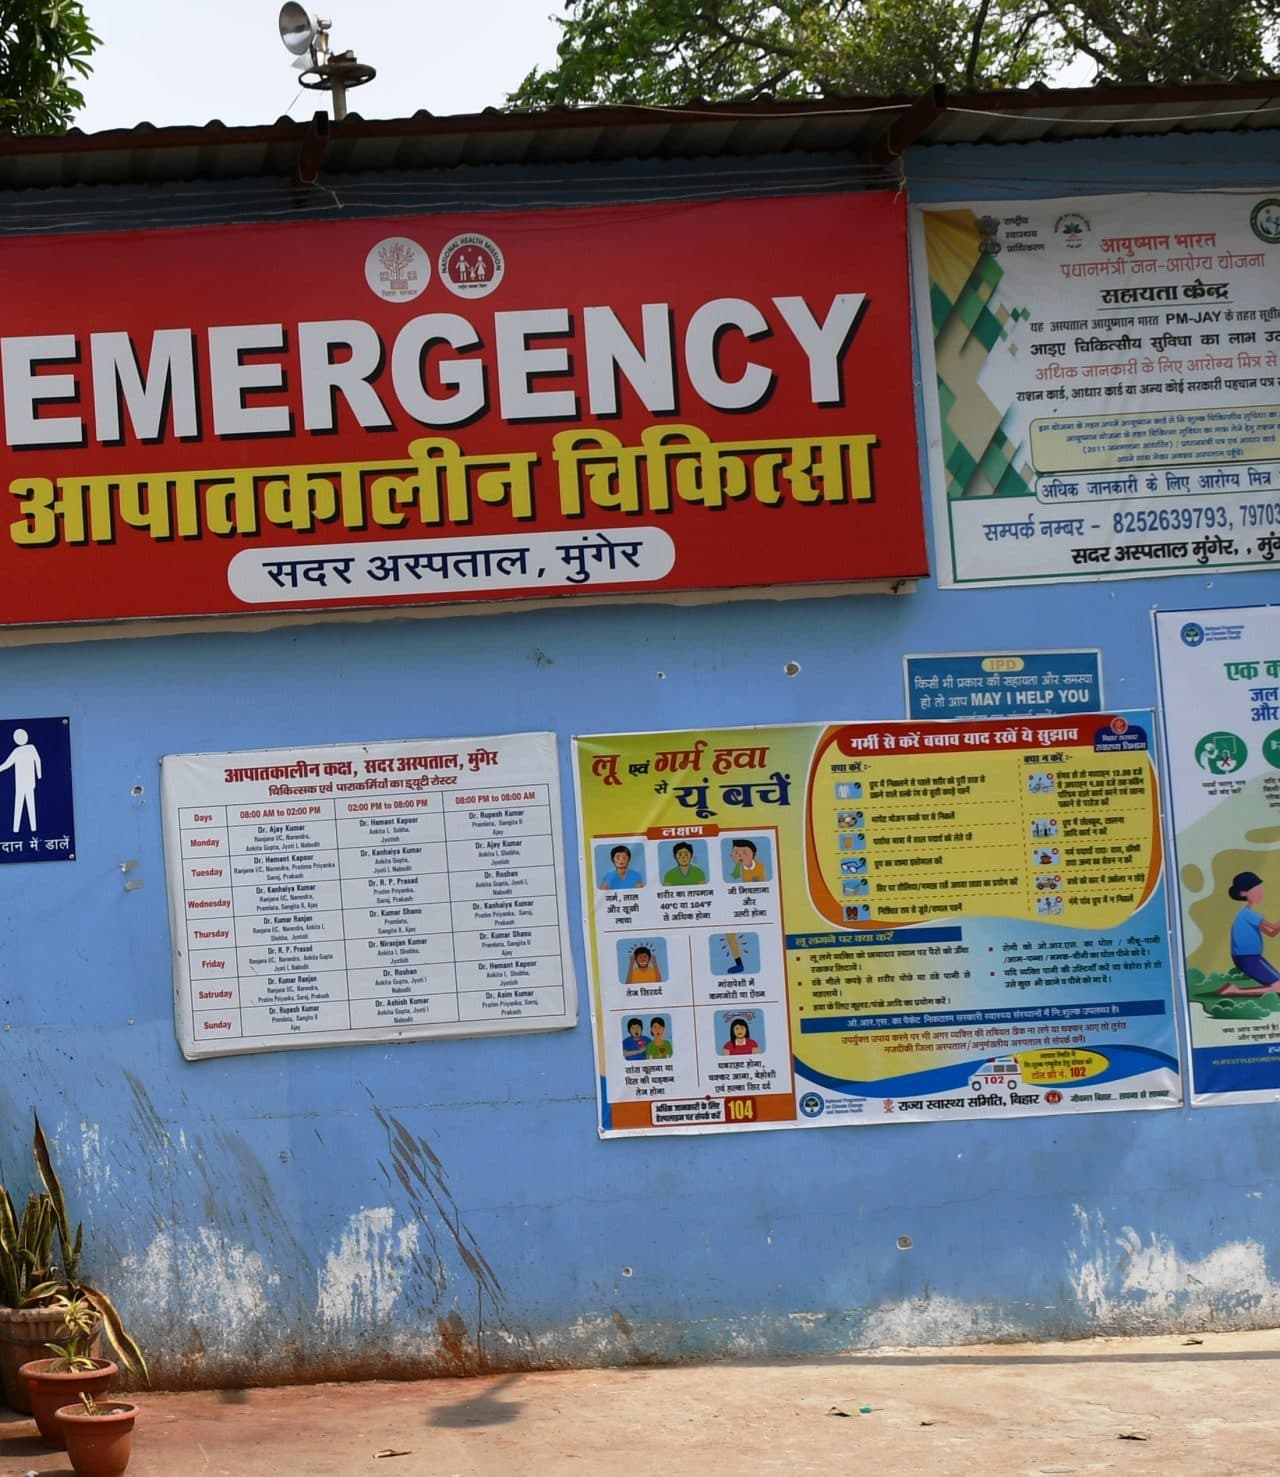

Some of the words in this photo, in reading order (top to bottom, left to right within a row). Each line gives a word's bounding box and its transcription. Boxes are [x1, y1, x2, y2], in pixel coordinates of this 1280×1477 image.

[1099, 234, 1170, 257] आयुष्मान
[1173, 232, 1216, 250] भारत
[442, 242, 460, 274] NATIONAL
[460, 237, 483, 245] HEALTH
[484, 242, 502, 271] MISSION
[1059, 258, 1129, 278] प्रधानमंत्री
[1127, 254, 1213, 274] जन-आरोग्य
[1216, 252, 1265, 269] योजना
[1099, 285, 1178, 304] सहायता
[1181, 279, 1229, 299] केन्द्र
[1165, 310, 1222, 325] PM-JAY
[1030, 342, 1066, 358] आइए
[1073, 333, 1142, 353] चिकित्सीय
[1149, 331, 1192, 352] सुविधा
[1199, 333, 1220, 345] का
[1227, 331, 1256, 344] लाभ
[0, 292, 868, 449] EMERGENCY
[1034, 363, 1079, 381] अधिक
[1080, 359, 1138, 377] जानकारी
[1140, 358, 1155, 373] के
[1157, 357, 1183, 375] लिए
[1186, 354, 1234, 371] आरोग्य
[1236, 352, 1262, 369] मित्र
[1263, 351, 1278, 367] से
[7, 437, 539, 546] आपातकालीन
[552, 424, 878, 517] चिकित्सा
[1040, 478, 1079, 498] अधिक
[1086, 474, 1138, 495] जानकारी
[1144, 473, 1158, 492] के
[1164, 472, 1190, 492] लिए
[1198, 469, 1240, 488] आरोग्य
[1247, 467, 1271, 486] मित्र
[981, 513, 1035, 541] सम्पर्क
[1038, 518, 1084, 538] नम्बर
[1112, 506, 1233, 534] 8252639793,
[1070, 546, 1111, 564] सदर
[1113, 541, 1189, 562] अस्पताल
[1191, 534, 1239, 564] मुंगेर,
[261, 557, 355, 588] सदर
[554, 533, 643, 584] मुंगेर
[989, 660, 1017, 670] IPD
[1224, 660, 1260, 681] एक
[913, 674, 939, 689] किसी
[941, 674, 954, 688] भी
[955, 676, 984, 688] प्रकार
[985, 672, 1000, 686] की
[1002, 674, 1038, 688] सहायता
[1041, 671, 1060, 685] और
[1061, 673, 1093, 684] समस्या
[919, 694, 931, 710] हो
[933, 693, 945, 707] तो
[948, 696, 968, 707] आप
[970, 691, 1002, 706] MAY
[1006, 691, 1011, 705] I
[1015, 689, 1054, 704] HELP
[1057, 688, 1089, 703] YOU
[1248, 687, 1278, 702] जल
[1251, 702, 1279, 722] और
[850, 733, 879, 750] गर्मी
[882, 732, 896, 749] से
[897, 731, 920, 748] करें
[922, 733, 960, 747] बचाव
[962, 731, 990, 745] याद
[992, 726, 1018, 744] रखें
[1020, 726, 1033, 742] ये
[1036, 727, 1078, 746] सुझाव
[223, 759, 321, 783] आपातकालीन
[322, 760, 358, 778] कक्ष,
[363, 758, 395, 774] सदर
[396, 753, 464, 772] अस्पताल,
[466, 747, 498, 772] मुंगेर
[592, 754, 622, 785] लू
[628, 760, 650, 777] एवं
[654, 740, 709, 773] गर्म
[712, 747, 770, 776] हवा
[369, 801, 382, 810] PM
[383, 801, 392, 810] to
[415, 798, 428, 807] PM
[476, 794, 490, 803] PM
[490, 794, 500, 802] to
[522, 791, 535, 800] AM
[654, 780, 668, 794] से
[672, 777, 718, 819] यूं
[719, 772, 791, 807] बचें
[194, 814, 213, 824] Days
[262, 808, 275, 818] AM
[276, 808, 285, 817] to
[308, 805, 321, 815] PM
[662, 826, 704, 837] लक्षण
[28, 836, 38, 851] में
[44, 834, 70, 850] डालें
[190, 840, 220, 848] Monday
[191, 869, 223, 878] Tuesday
[188, 900, 231, 909] Wednesday
[194, 930, 230, 939] Thursday
[202, 960, 226, 969] Friday
[204, 1021, 232, 1030] Sunday
[983, 1076, 1005, 1085] 102
[1070, 1066, 1087, 1078] 102
[728, 1100, 753, 1120] 104
[896, 1096, 924, 1112] राज्य
[925, 1097, 965, 1110] स्वास्थ्य
[966, 1092, 1007, 1108] समिति,
[1009, 1091, 1040, 1105] बिहार
